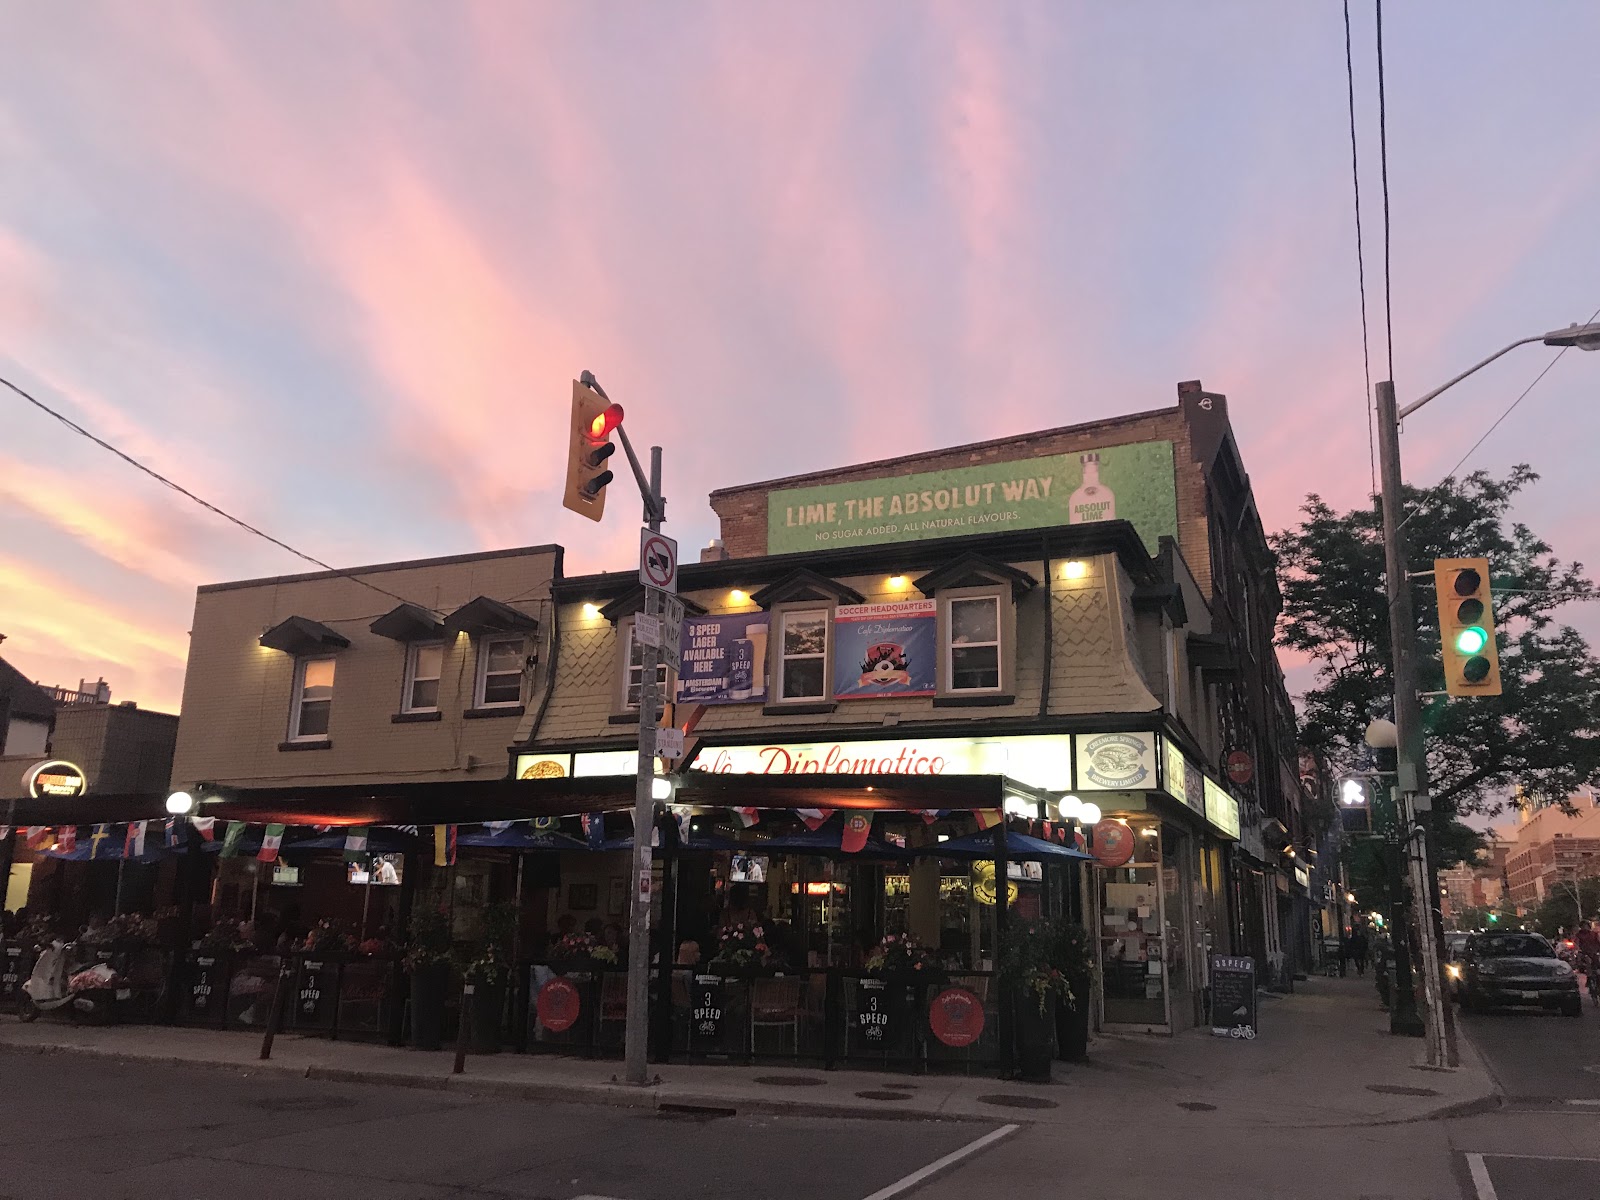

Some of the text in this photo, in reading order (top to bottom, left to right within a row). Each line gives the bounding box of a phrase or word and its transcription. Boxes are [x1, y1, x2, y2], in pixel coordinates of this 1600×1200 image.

[786, 476, 1053, 526] LIME, THE ABSOLUT WAY
[1073, 502, 1111, 515] ABSOLUT
[1081, 511, 1104, 521] LIME
[815, 532, 830, 541] NO
[832, 528, 863, 540] SUGAR
[903, 522, 920, 532] ALL
[922, 516, 966, 530] NATURAL
[968, 511, 1021, 526] FLAVOURS.
[667, 598, 682, 624] TWO
[839, 601, 933, 616] SOCCER HEADQUARTERS
[665, 621, 680, 644] WAY
[689, 624, 721, 636] 3 SPEED
[692, 636, 717, 648] LAGER
[683, 648, 725, 661] AVAILABLE
[739, 648, 744, 660] 3
[693, 661, 714, 673] HERE
[731, 660, 751, 671] SPEED
[685, 677, 722, 687] AMSTERDAM
[666, 730, 674, 739] NO
[1119, 735, 1143, 749] SPRINGS
[1091, 773, 1143, 787] BREWERY LIMITED
[1222, 959, 1251, 970] SPEED
[201, 971, 207, 985] 3
[308, 975, 315, 989] 3
[193, 985, 212, 996] SPEED
[300, 989, 321, 1000] SPEED
[704, 992, 712, 1007] 3
[870, 996, 877, 1012] 3
[694, 1007, 721, 1020] SPEED
[860, 1013, 888, 1026] SPEED
